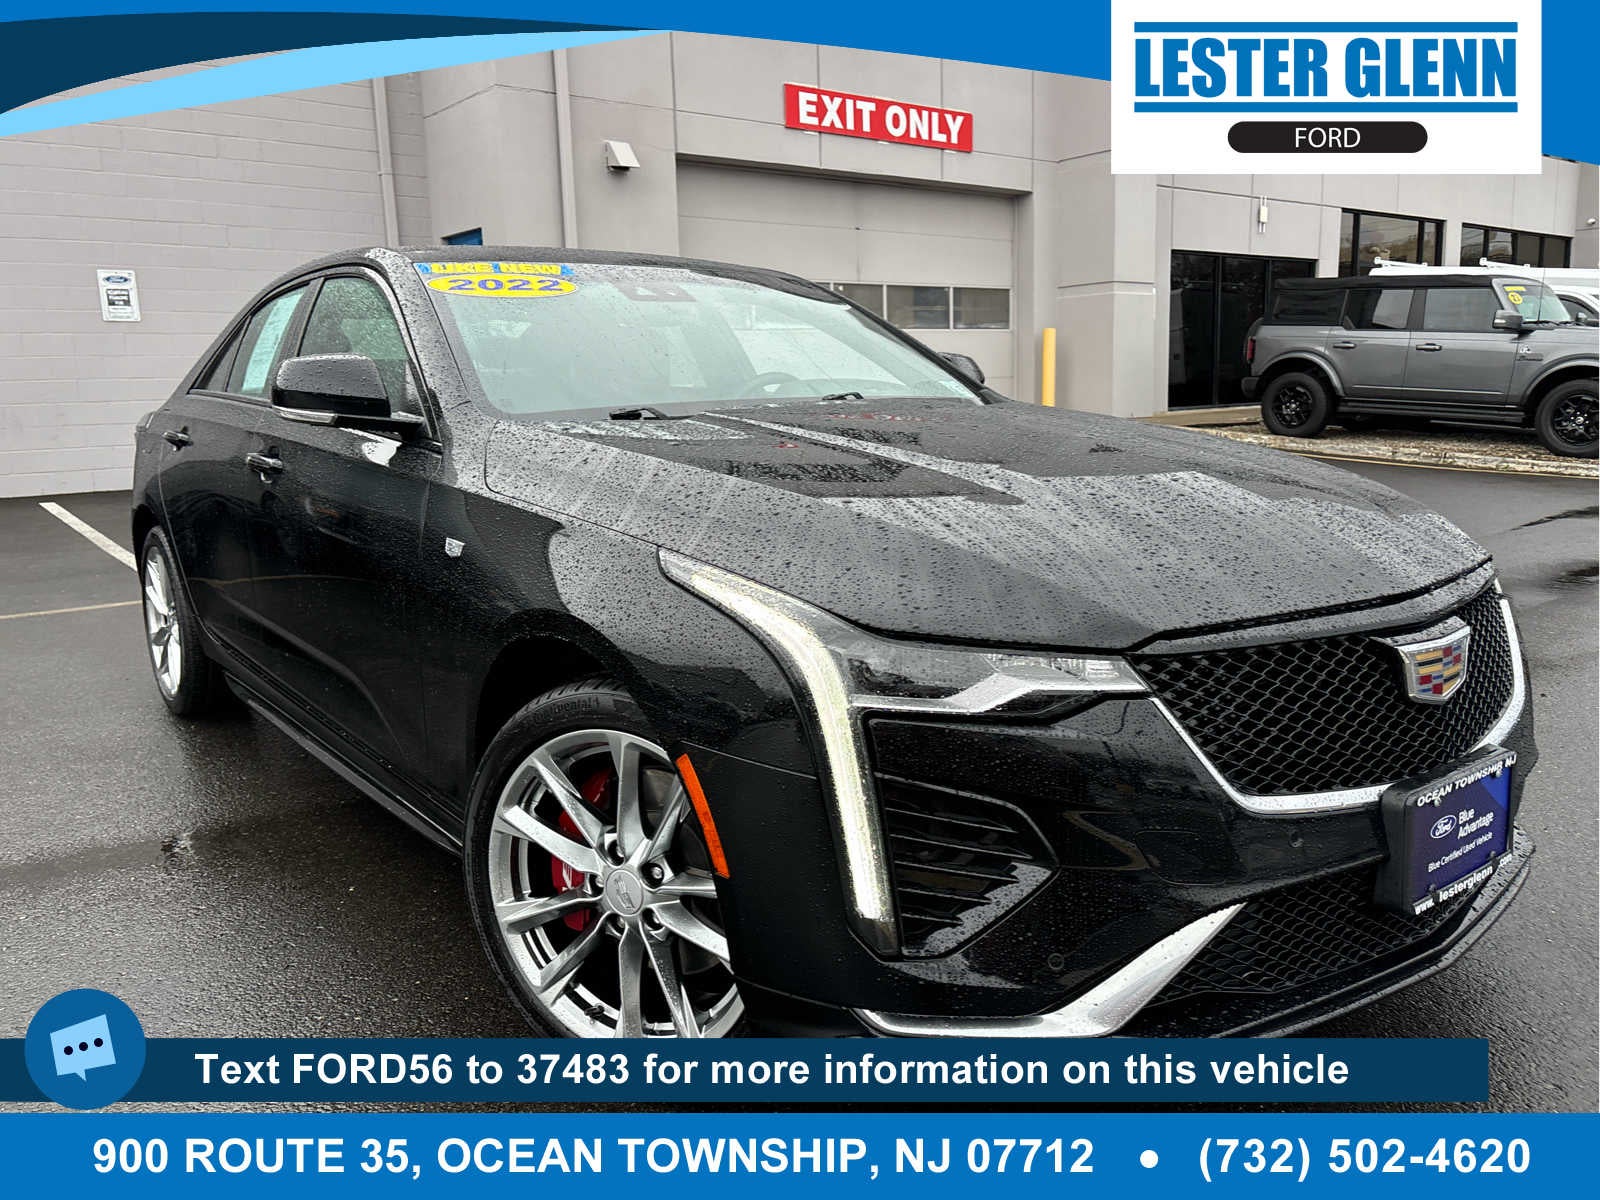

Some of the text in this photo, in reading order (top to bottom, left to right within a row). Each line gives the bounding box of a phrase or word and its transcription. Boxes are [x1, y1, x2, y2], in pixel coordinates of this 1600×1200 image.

[798, 91, 965, 145] EXIT ONLY
[499, 263, 561, 275] NEW
[449, 278, 563, 291] 2022
[1417, 755, 1518, 807] OCEAN TOWNSHIP NJ
[1457, 812, 1494, 839] Advantage
[1458, 808, 1475, 825] Blue
[1428, 861, 1441, 873] Blue
[1414, 898, 1435, 916] www.
[1439, 865, 1493, 902] lesterglenn
